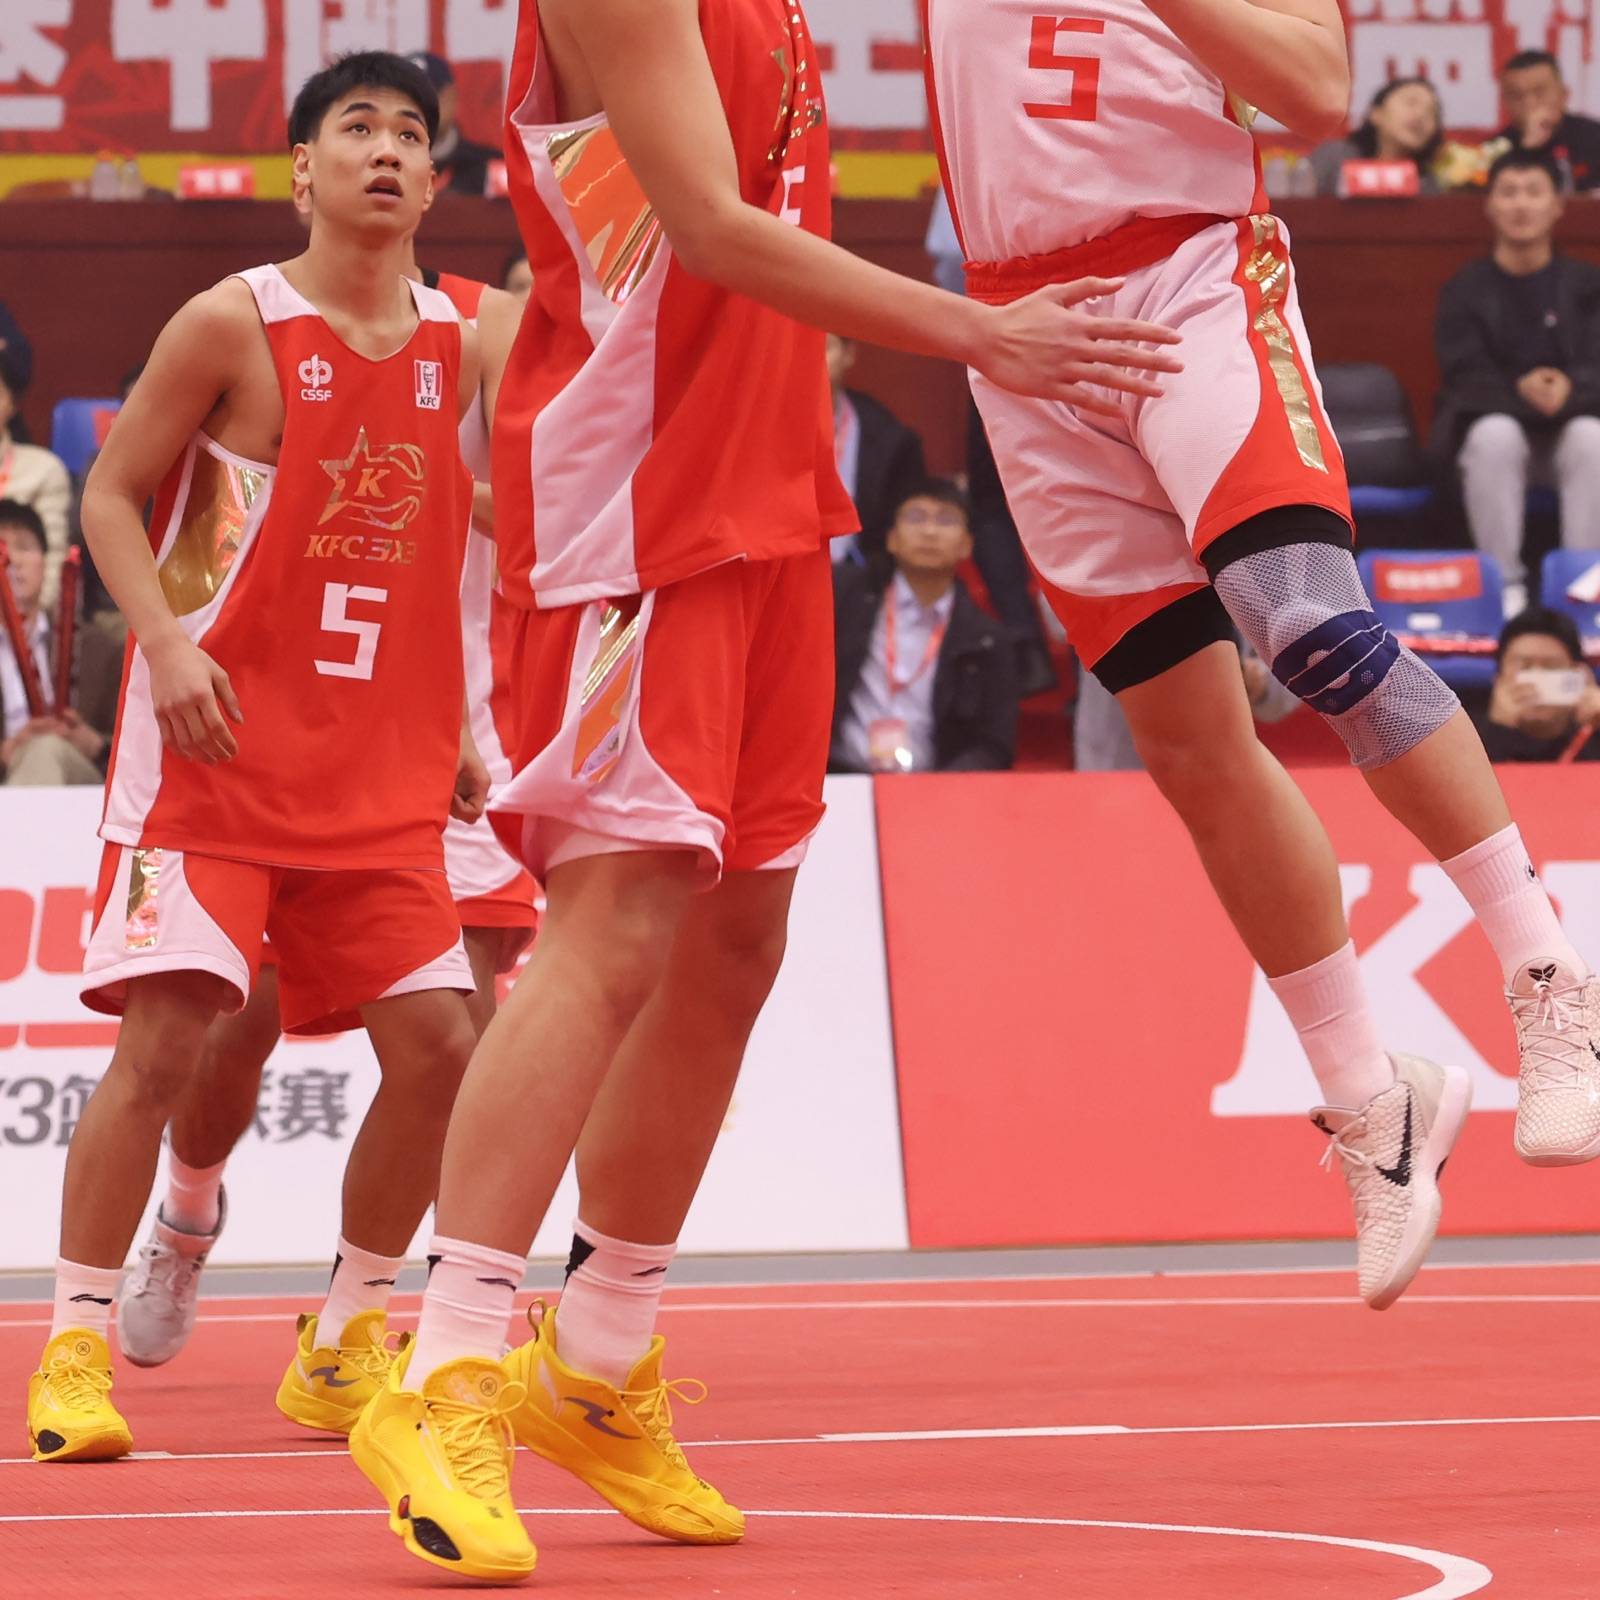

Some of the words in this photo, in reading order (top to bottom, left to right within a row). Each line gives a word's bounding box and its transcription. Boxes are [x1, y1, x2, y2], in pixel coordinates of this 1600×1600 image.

[1022, 16, 1105, 122] 5
[301, 388, 333, 402] CSSF
[419, 396, 437, 408] KFC
[303, 535, 365, 560] KFC
[313, 582, 388, 681] 5
